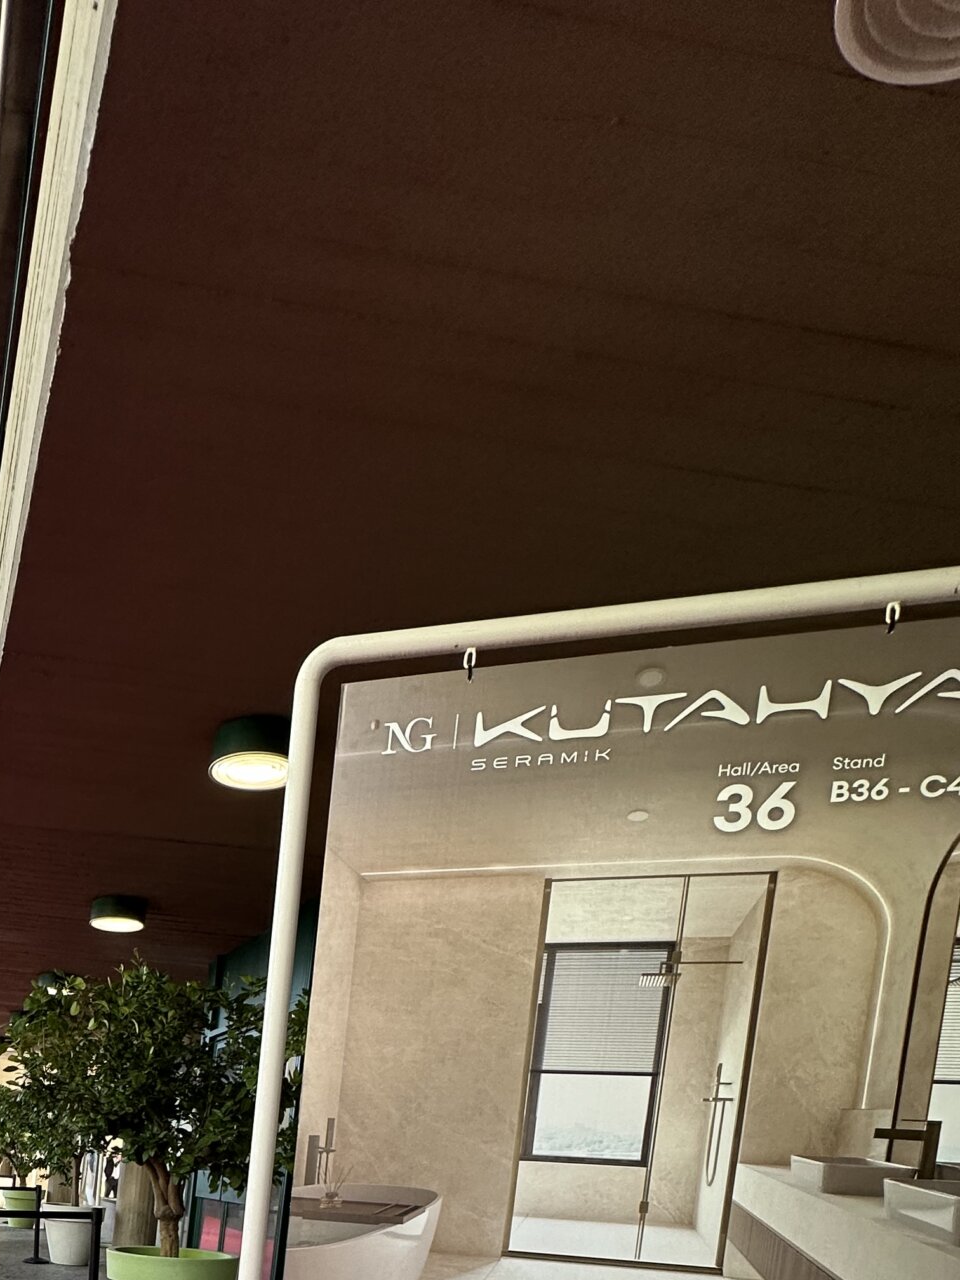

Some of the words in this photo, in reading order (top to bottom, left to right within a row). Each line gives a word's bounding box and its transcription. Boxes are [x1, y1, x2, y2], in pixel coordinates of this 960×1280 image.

[381, 717, 437, 755] NG
[718, 761, 800, 777] Hall/Area
[832, 753, 886, 771] Stand
[830, 777, 889, 803] B36
[713, 781, 797, 833] 36
